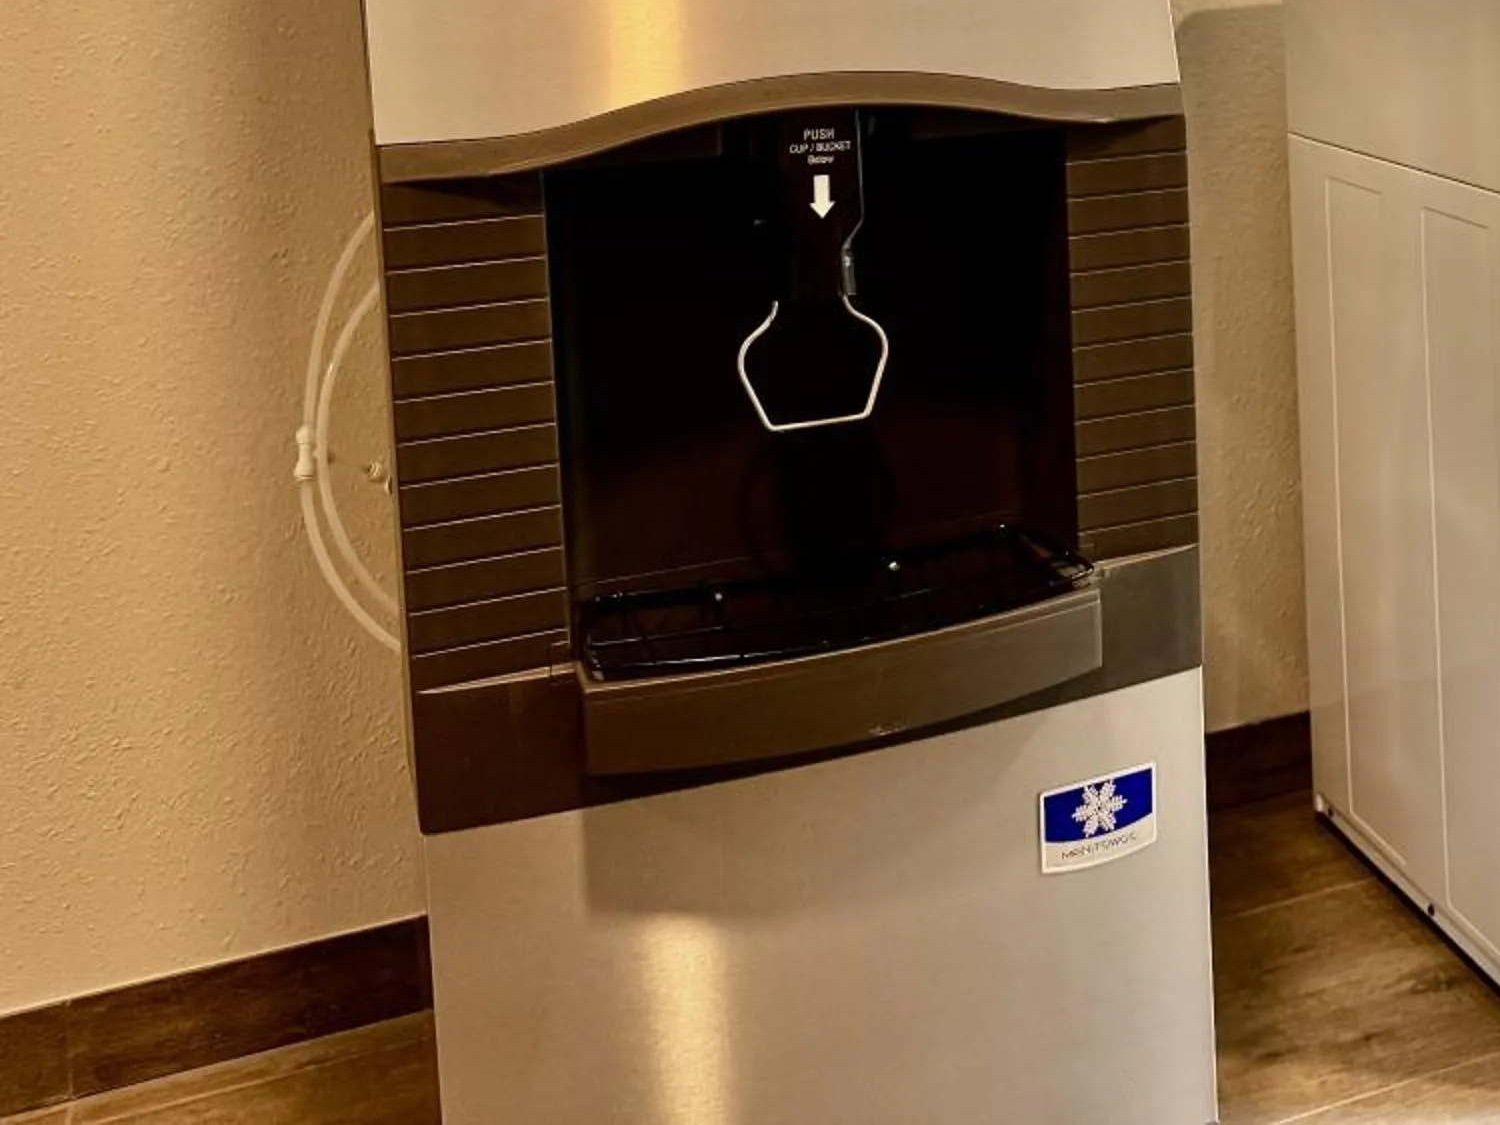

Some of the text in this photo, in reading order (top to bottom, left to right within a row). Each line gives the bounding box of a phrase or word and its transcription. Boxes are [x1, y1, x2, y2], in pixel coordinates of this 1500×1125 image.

[803, 127, 836, 141] PUSH
[789, 144, 809, 154] CUP
[816, 140, 851, 152] BUCKET
